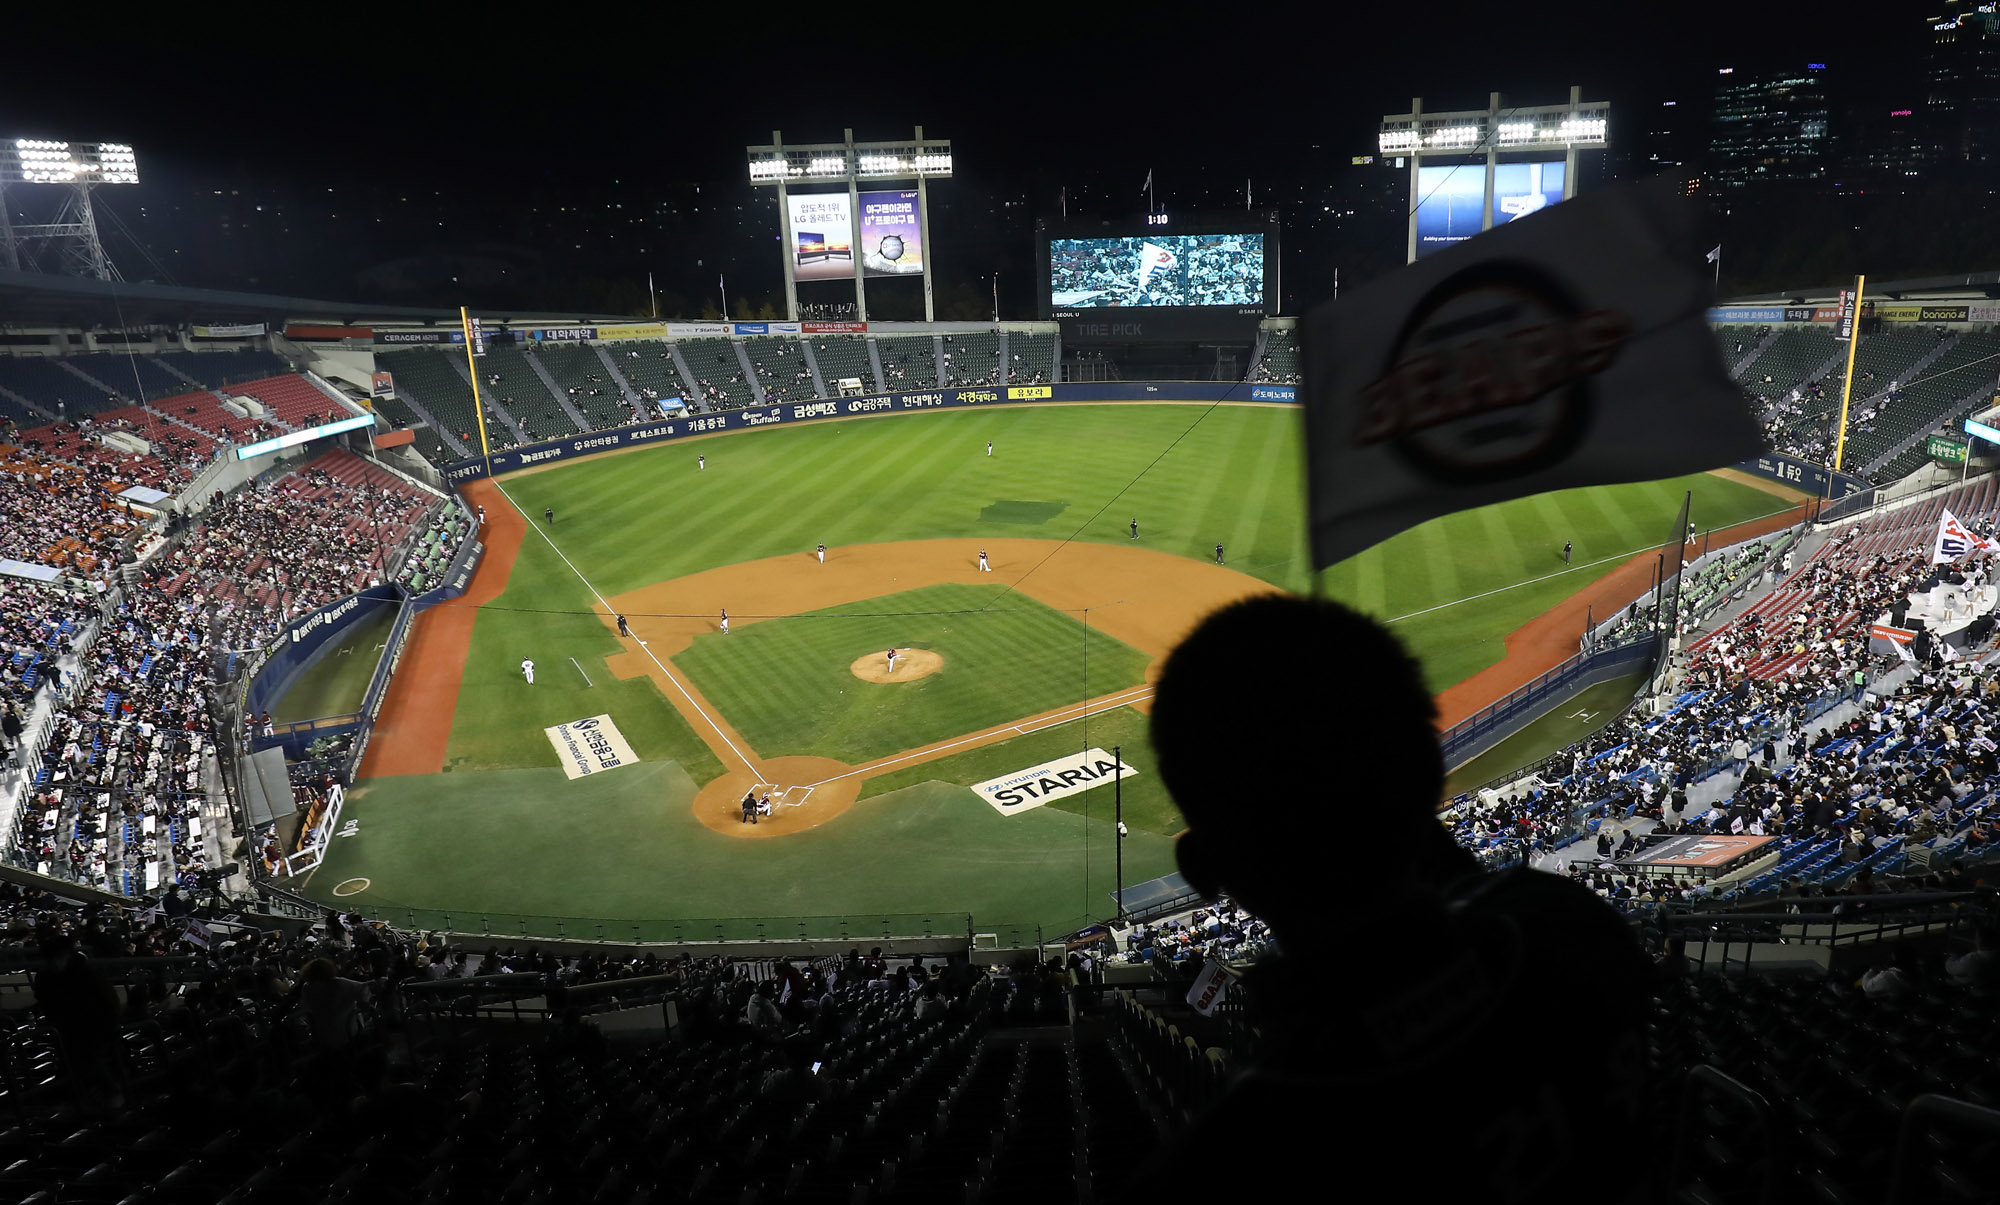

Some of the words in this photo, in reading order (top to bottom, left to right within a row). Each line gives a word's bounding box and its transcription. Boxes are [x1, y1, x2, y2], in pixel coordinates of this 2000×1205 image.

[1934, 22, 1957, 31] KT&G
[800, 203, 826, 214] 압도적
[828, 203, 840, 212] 1위
[865, 202, 913, 214] 야구팬이라면
[794, 215, 807, 224] LG
[809, 213, 834, 223] 올레드
[835, 213, 847, 222] TV
[1148, 214, 1169, 225] 1:10
[546, 329, 592, 340] 대화제약
[1076, 324, 1109, 336] TIRE
[1112, 323, 1142, 336] PICK
[384, 334, 421, 342] CERAGEM
[956, 391, 998, 404] 서경대학교
[1017, 388, 1044, 397] 유보라
[1260, 390, 1296, 400] 도미노피자
[862, 397, 892, 411] 금강주택
[902, 393, 943, 407] 현대해상
[793, 402, 838, 418] 금성백조
[688, 416, 726, 432] 키움증권
[750, 416, 781, 425] Buffalo
[583, 435, 619, 448] 유안타증권
[531, 447, 562, 461] 곰표밀가루
[1930, 443, 1956, 458] 올원뱅크
[1786, 464, 1802, 483] 듀오
[557, 724, 572, 742] Shinhan
[567, 740, 587, 761] Financial
[577, 757, 592, 775] Group
[582, 729, 621, 769] 신한금융그룹
[994, 760, 1126, 807] STARIA
[1004, 768, 1051, 787] HYUNDAI
